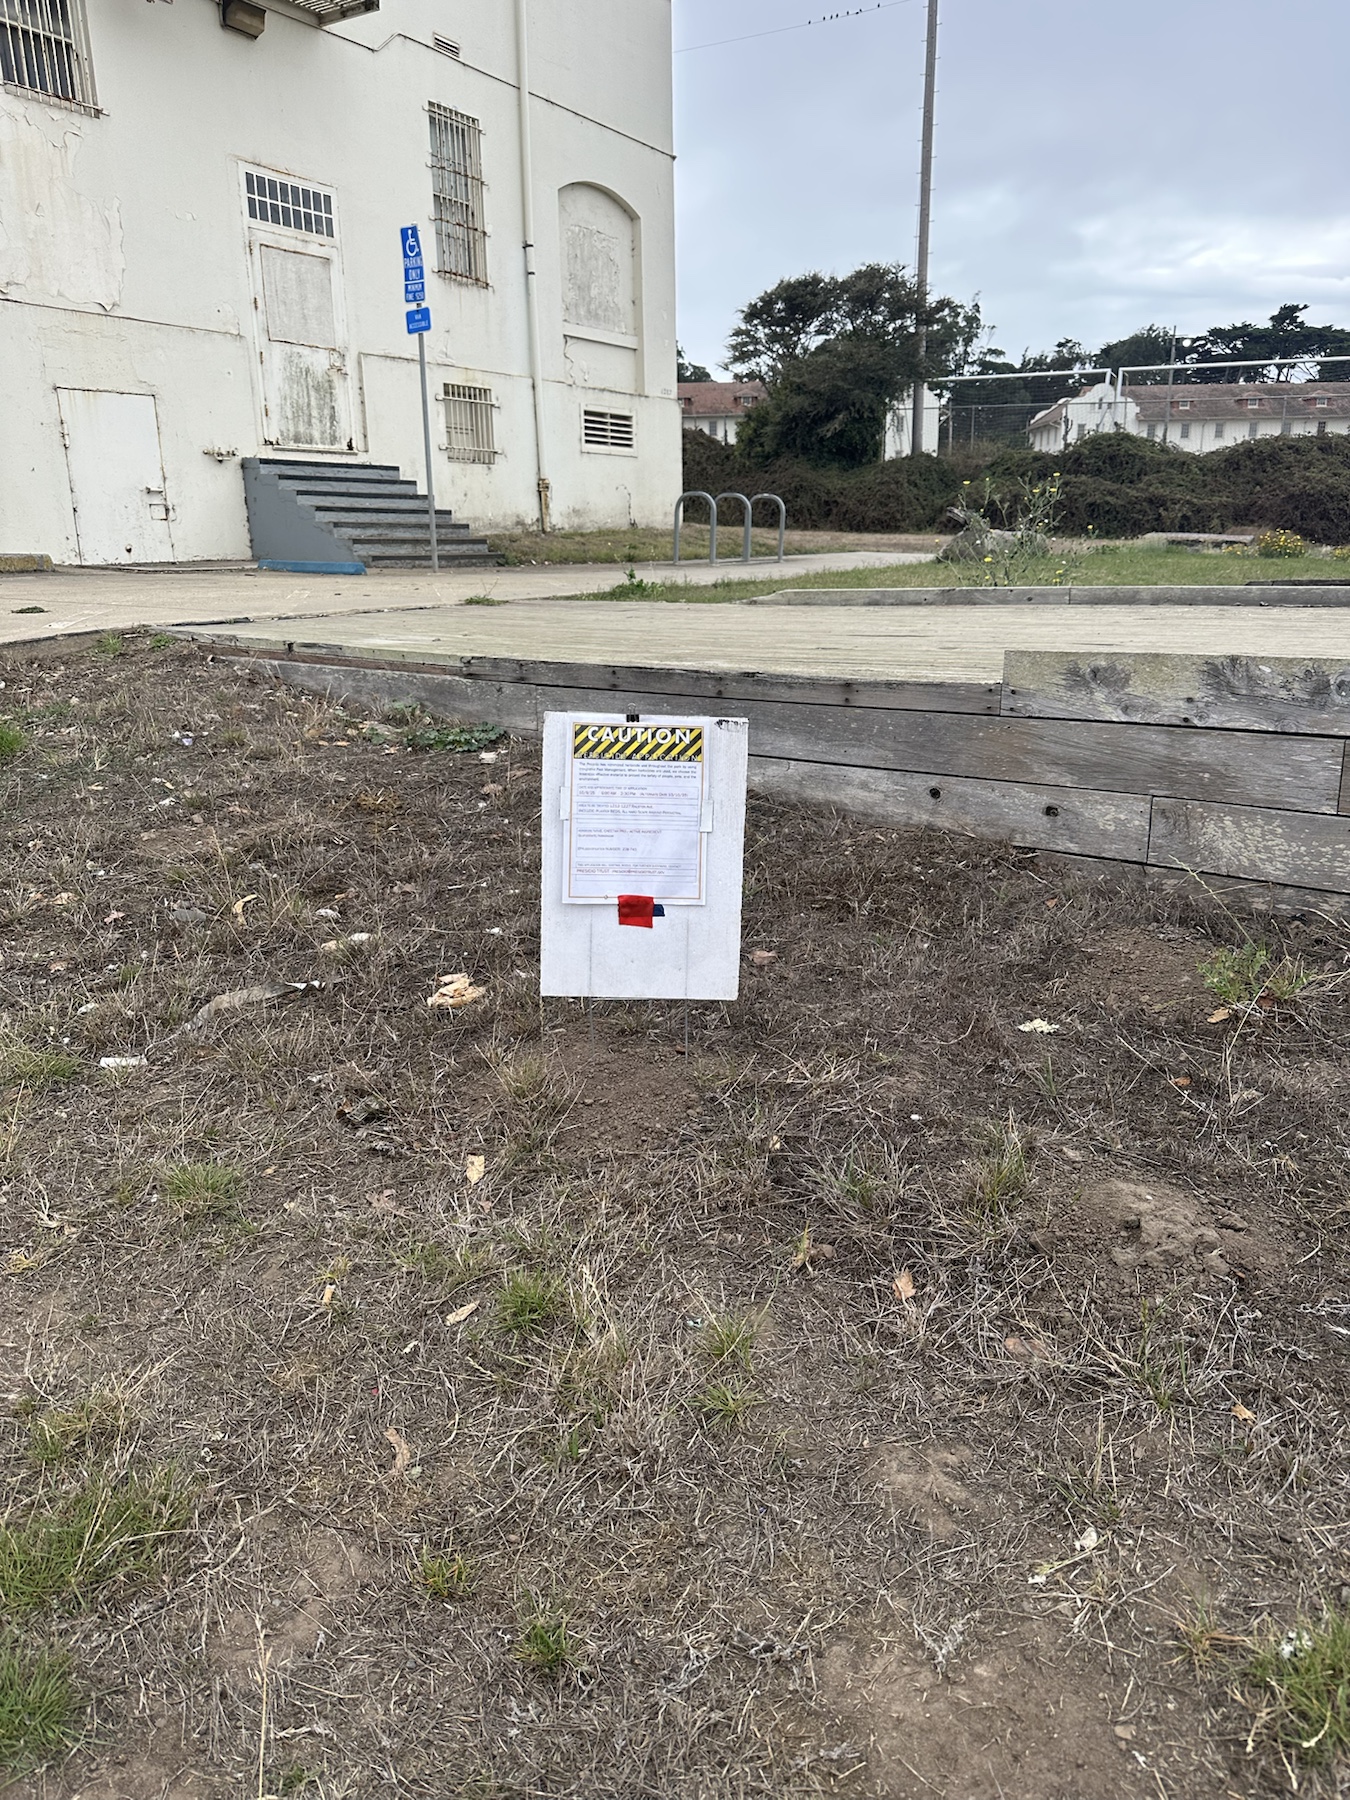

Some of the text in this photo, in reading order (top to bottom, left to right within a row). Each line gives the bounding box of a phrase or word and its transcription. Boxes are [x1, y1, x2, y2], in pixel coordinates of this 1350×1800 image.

[404, 256, 422, 268] PARKING
[408, 269, 420, 280] ONLY
[588, 726, 690, 744] CAUTION
[632, 753, 698, 762] APPLICATION
